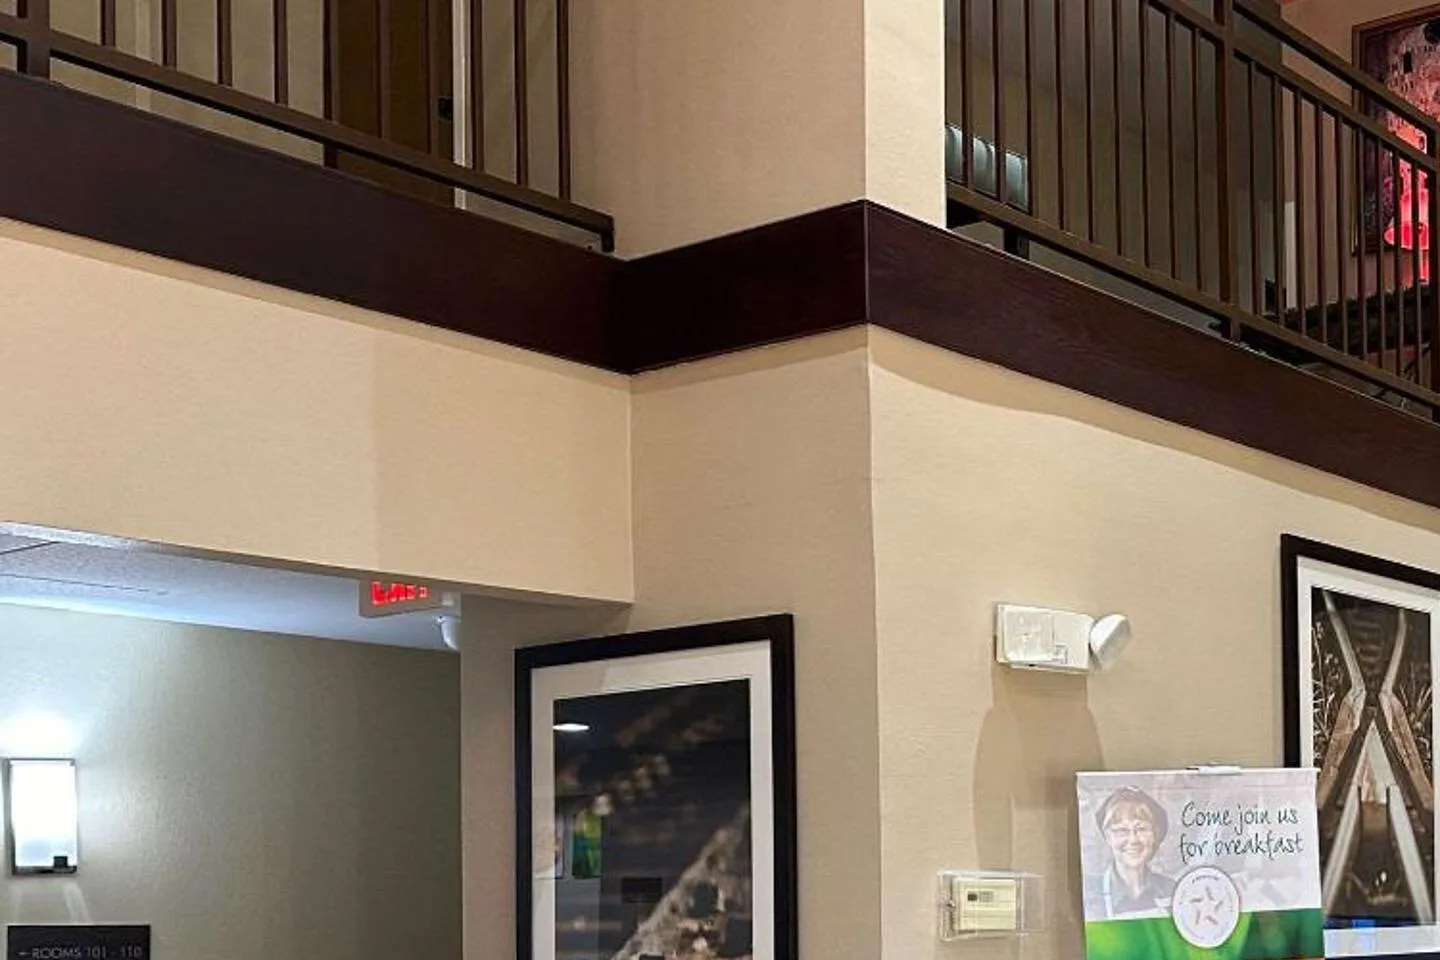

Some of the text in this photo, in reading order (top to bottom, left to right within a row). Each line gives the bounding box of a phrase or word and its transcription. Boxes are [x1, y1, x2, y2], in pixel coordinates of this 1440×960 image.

[1181, 800, 1299, 836] Come join us
[1178, 830, 1304, 865] for breakfast
[31, 947, 83, 960] ROOMS
